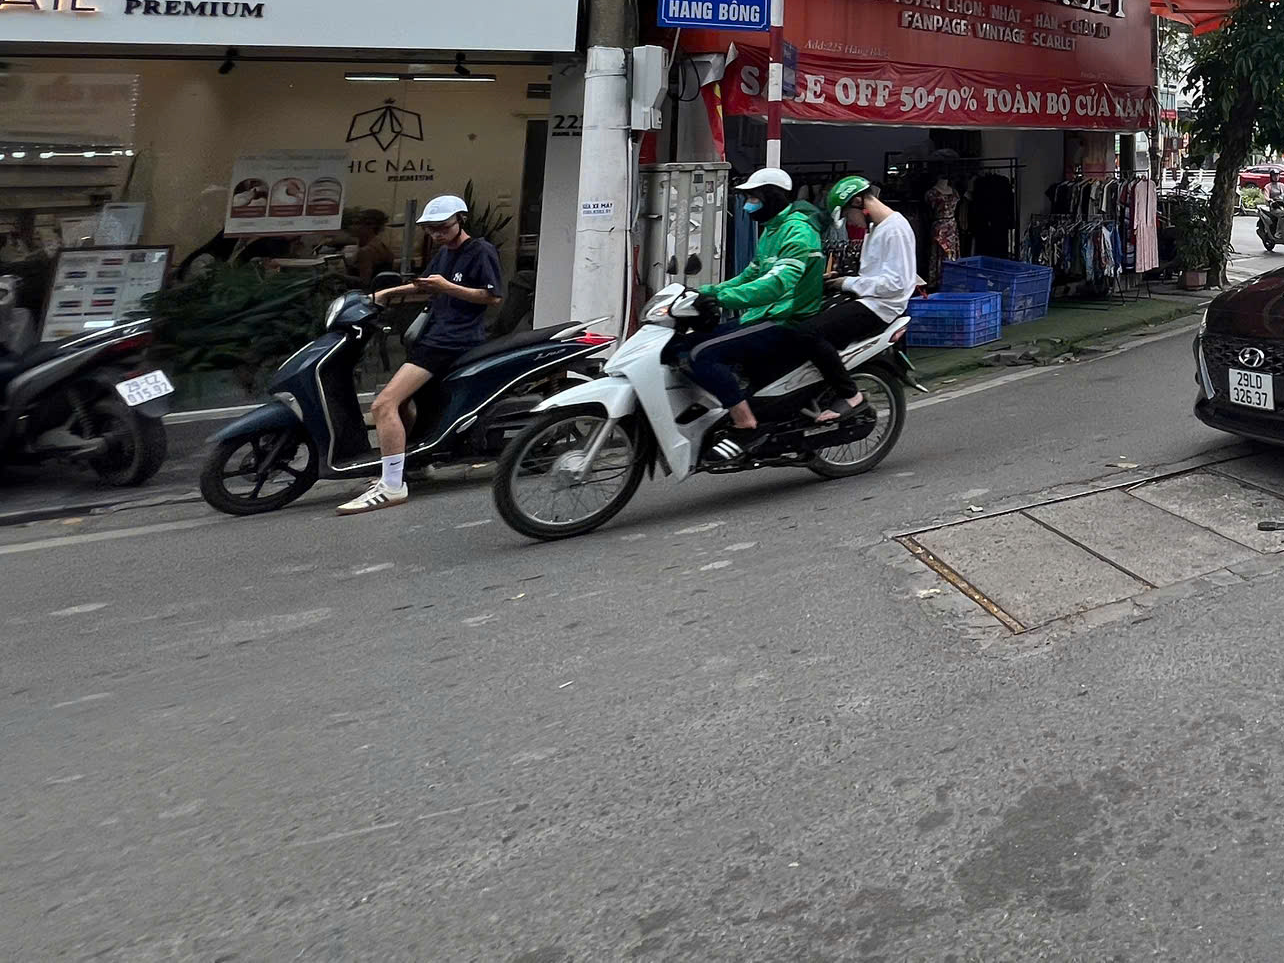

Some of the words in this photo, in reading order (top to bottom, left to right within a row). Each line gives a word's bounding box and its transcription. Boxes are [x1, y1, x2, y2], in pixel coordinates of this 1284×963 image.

[124, 0, 265, 18] PREMIUM
[719, 0, 760, 22] BÔNG
[901, 11, 973, 36] FANPAGE:
[977, 22, 1026, 44] VINTAGE
[1032, 31, 1078, 51] SCARLET
[740, 65, 826, 104] SE
[835, 77, 894, 108] OFF
[900, 85, 978, 114] 50-70%
[984, 83, 1042, 115] TOÀN
[1046, 87, 1071, 120] BỘ
[553, 114, 584, 130] 22
[385, 158, 435, 173] NAIL
[1236, 371, 1263, 389] 29LD
[1233, 387, 1268, 407] 326.37
